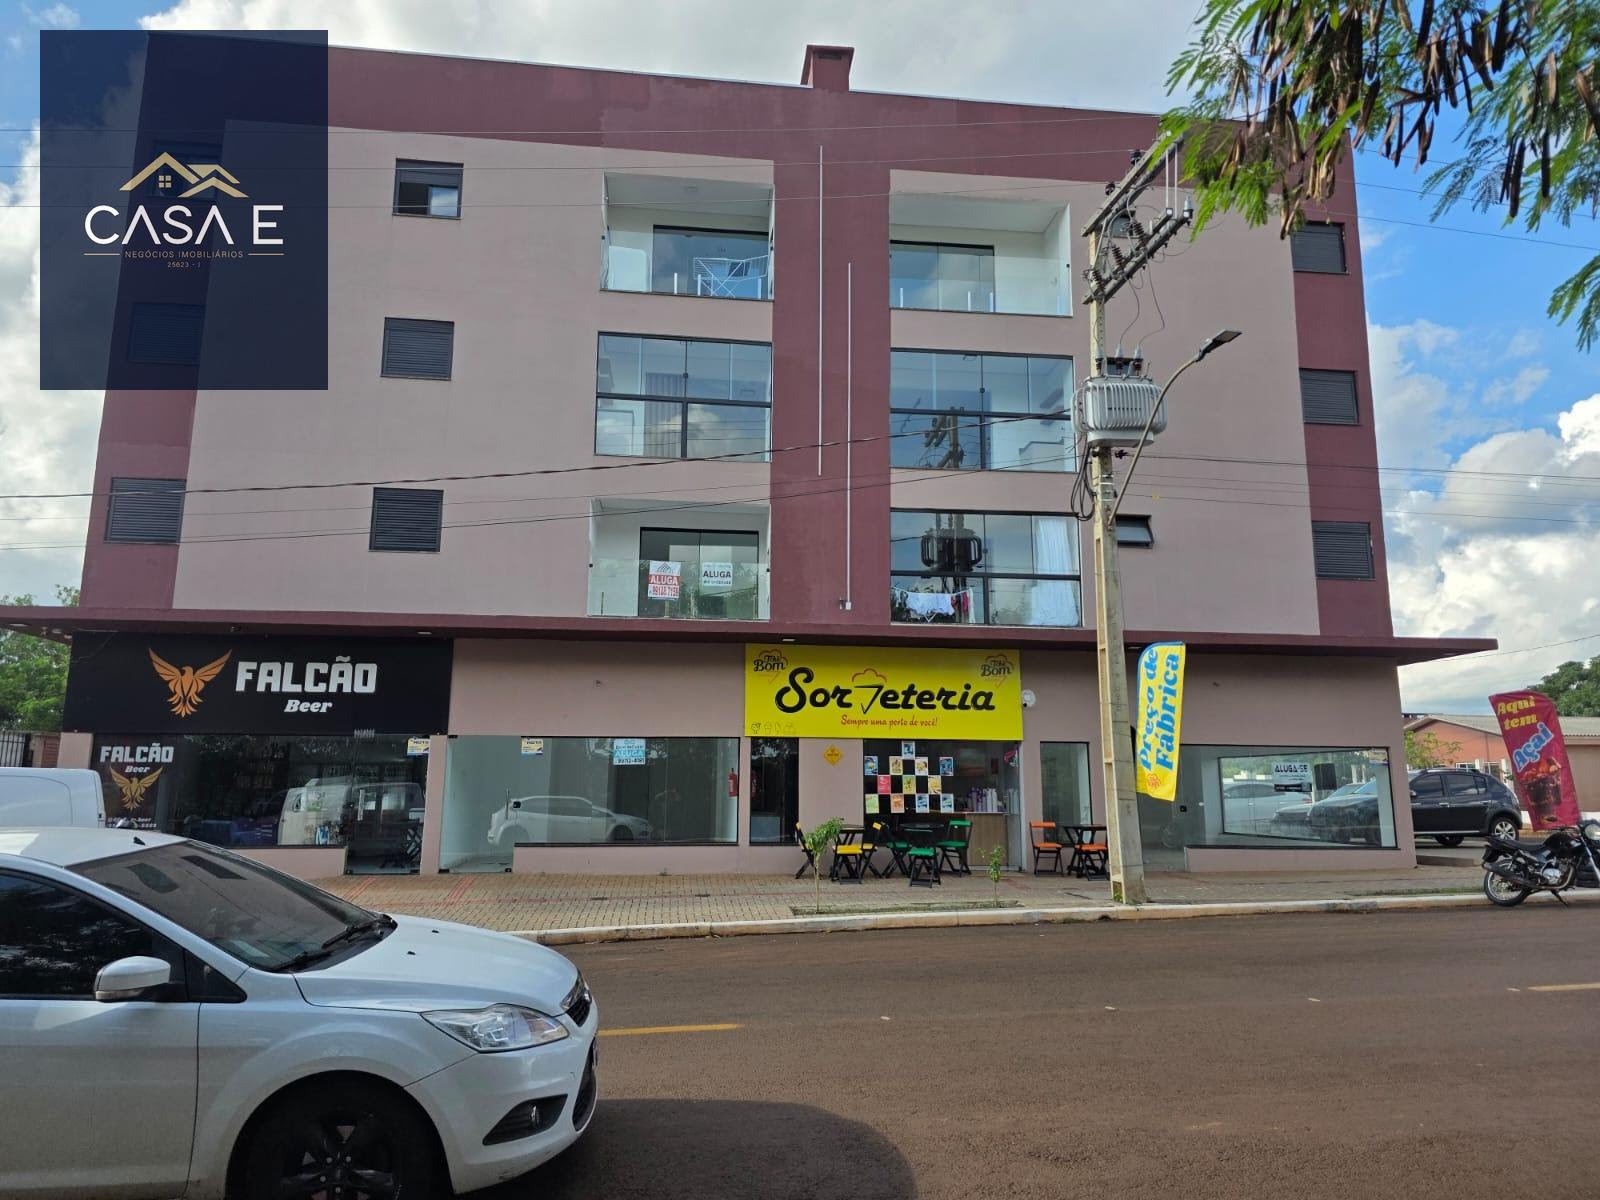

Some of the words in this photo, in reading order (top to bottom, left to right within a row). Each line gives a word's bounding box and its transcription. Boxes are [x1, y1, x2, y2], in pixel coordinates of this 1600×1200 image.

[650, 575, 678, 586] ALUGA
[703, 570, 731, 578] ALUGA
[753, 659, 785, 671] Bom
[980, 664, 1012, 676] Bom
[1144, 648, 1158, 680] de
[235, 656, 378, 694] FALCÃO
[284, 699, 333, 713] Beer
[1155, 654, 1179, 770] Fábrica
[1497, 696, 1536, 716] Aqui
[841, 714, 869, 729] Sempre
[909, 715, 918, 726] de
[1140, 686, 1159, 771] Preço
[1504, 714, 1537, 731] tem
[100, 742, 174, 763] FALCÃO
[125, 765, 151, 773] Beer
[1275, 764, 1308, 773] ALUGA-SE
